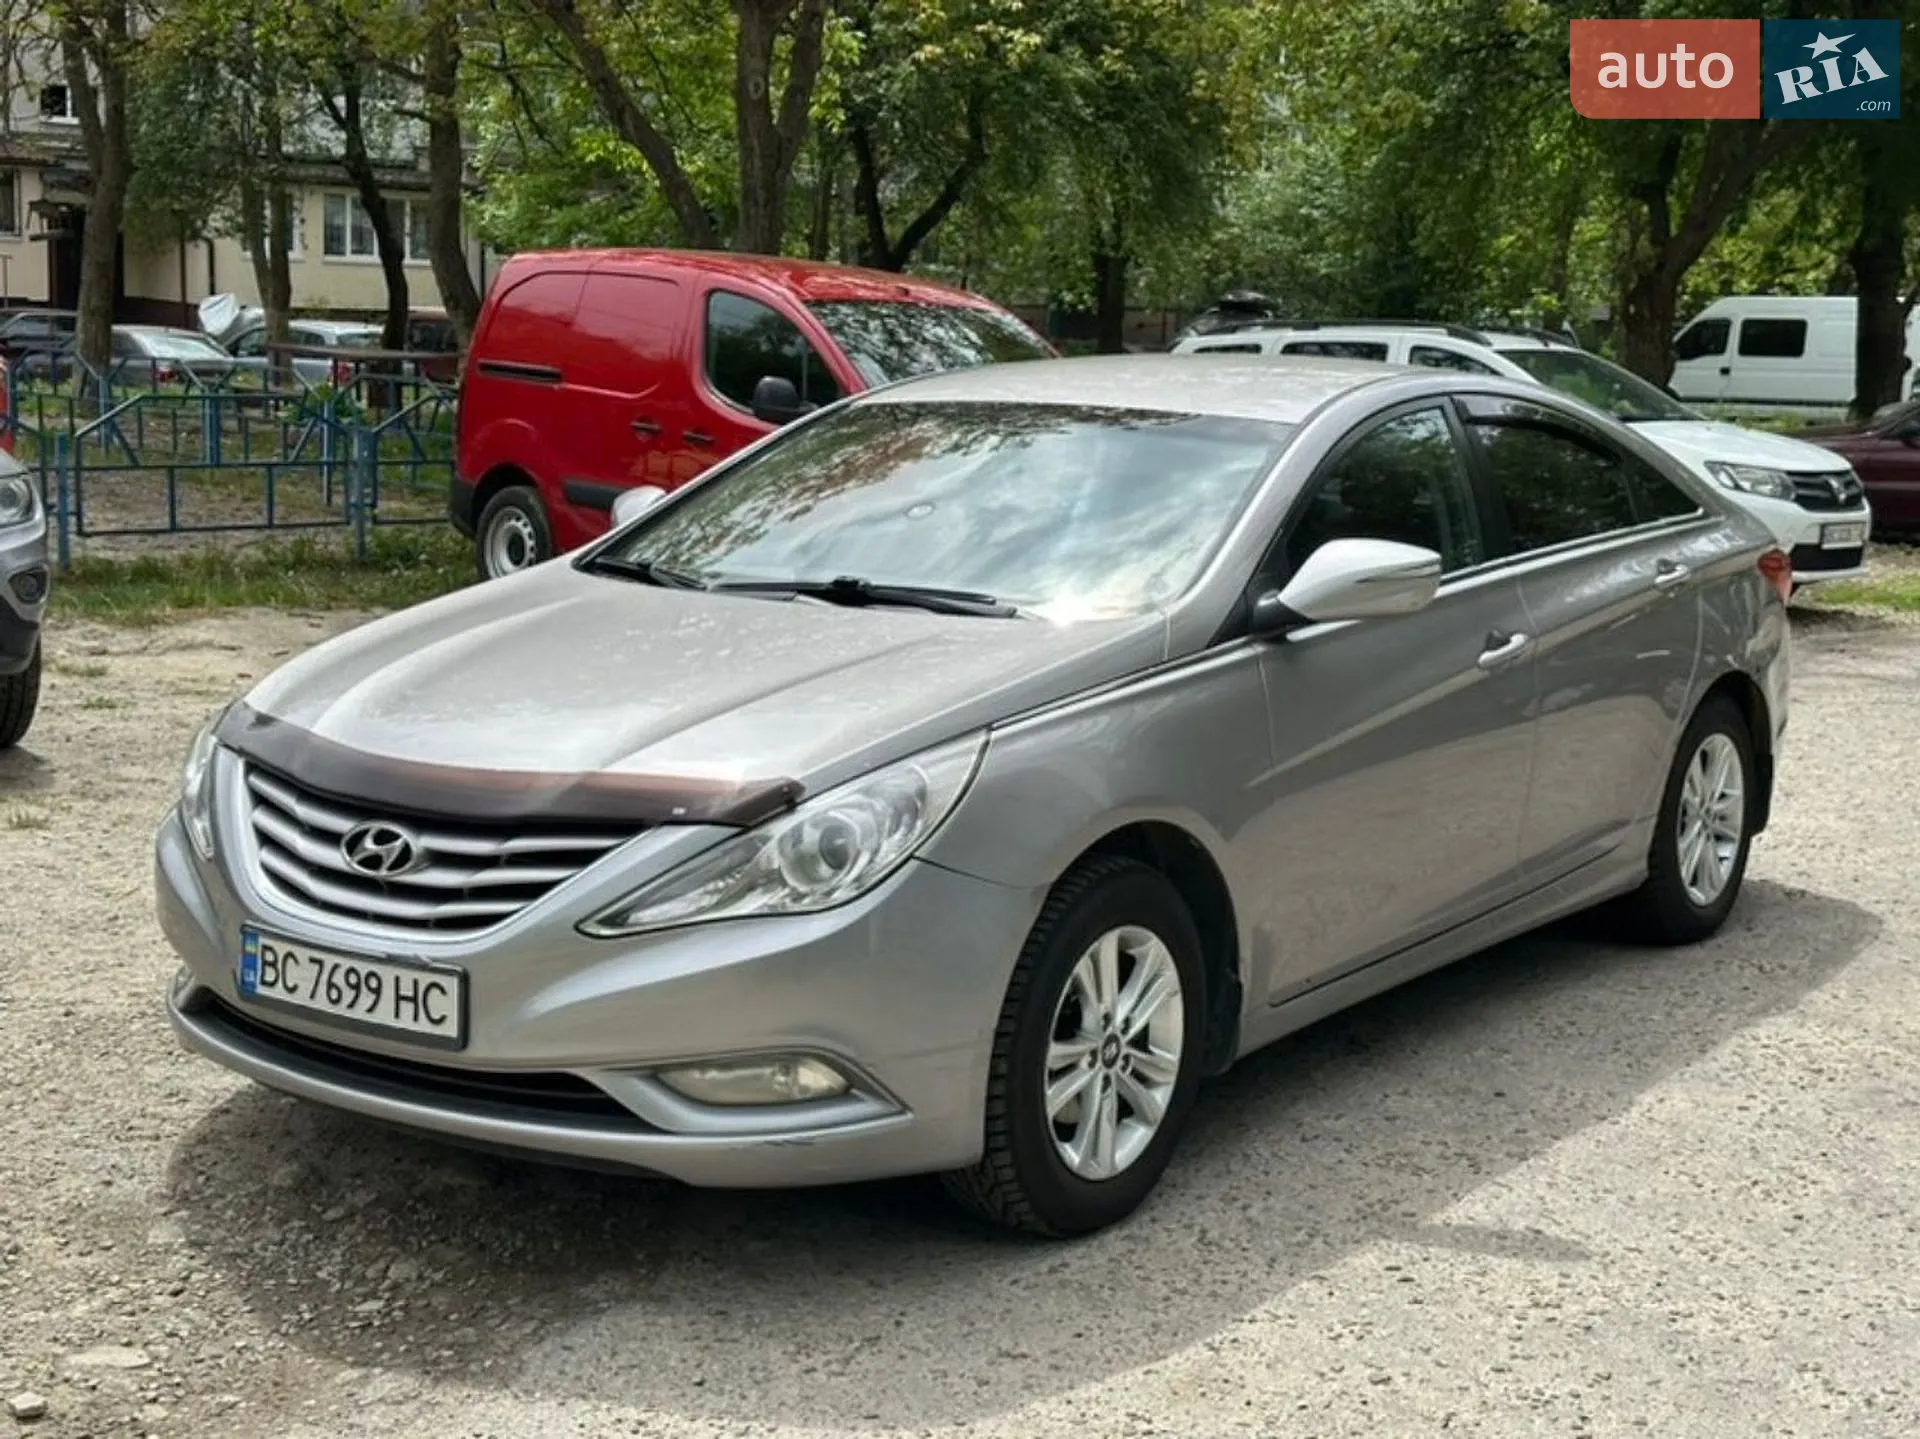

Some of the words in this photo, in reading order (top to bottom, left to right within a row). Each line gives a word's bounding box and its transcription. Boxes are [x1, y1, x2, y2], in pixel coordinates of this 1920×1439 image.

[260, 945, 300, 994] BC
[308, 957, 383, 1013] 7699
[394, 975, 448, 1025] HC
